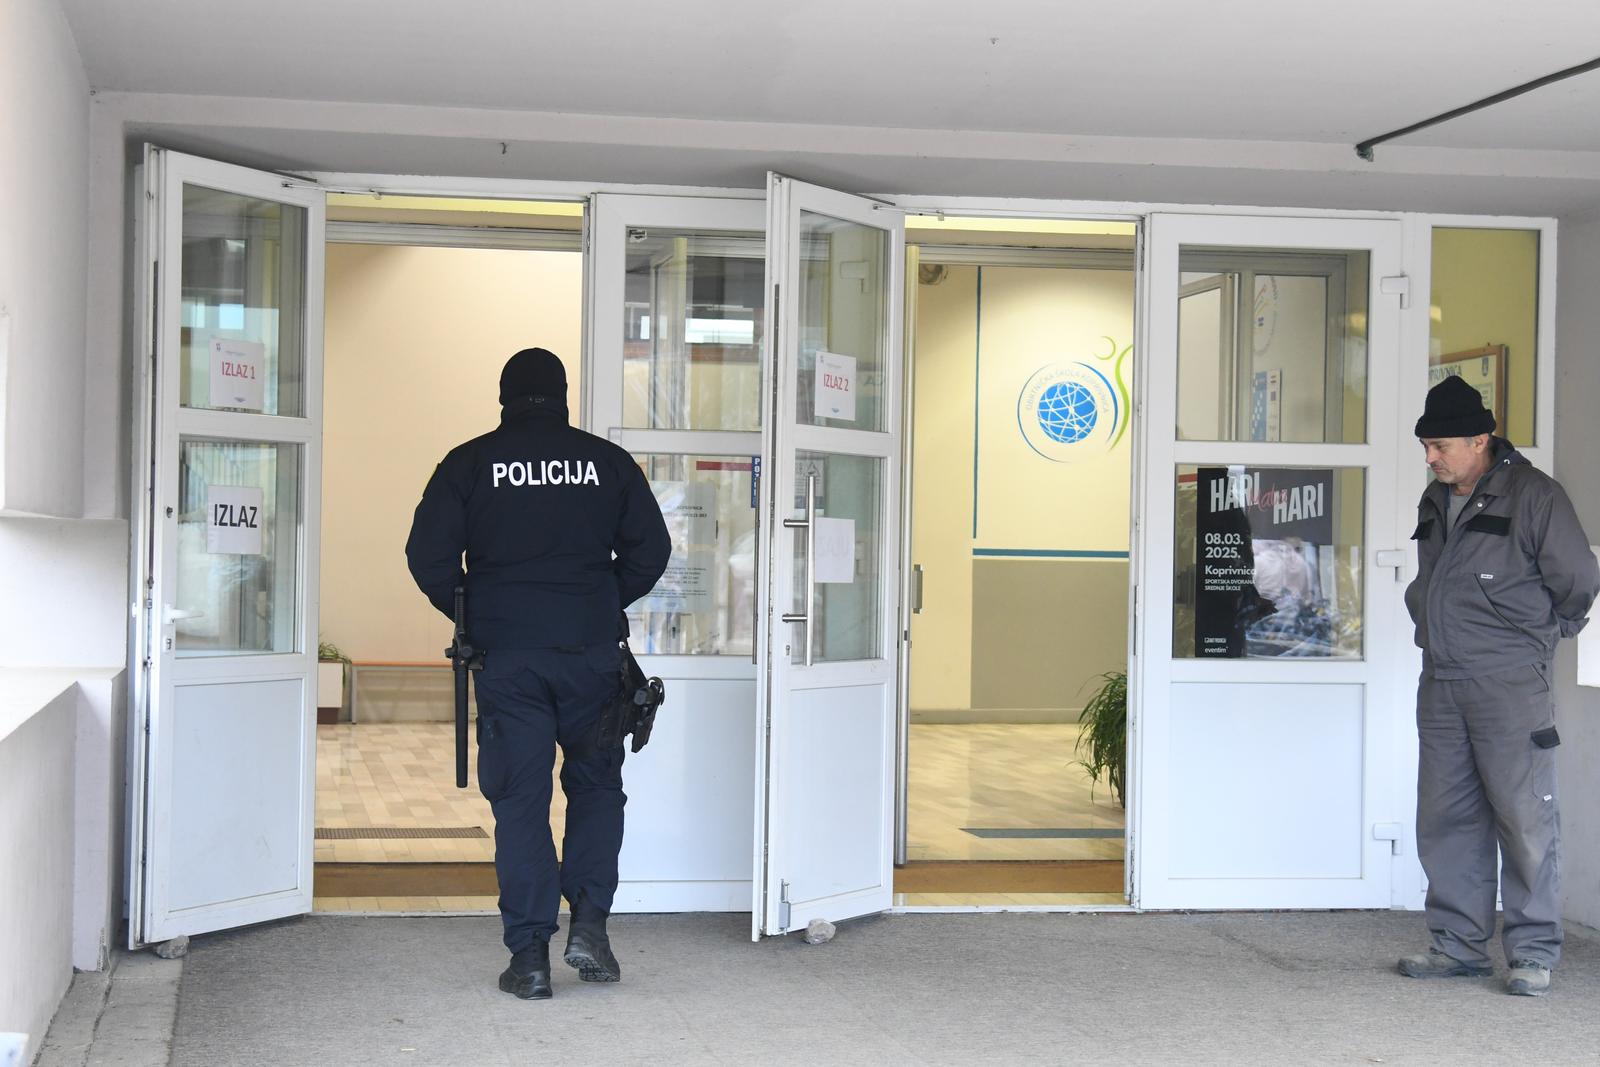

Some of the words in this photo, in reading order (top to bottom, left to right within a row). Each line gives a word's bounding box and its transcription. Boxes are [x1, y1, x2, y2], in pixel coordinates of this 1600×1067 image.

[221, 360, 249, 379] IZLAZ
[250, 365, 256, 380] 1
[823, 373, 843, 391] IZLAZ
[843, 378, 849, 392] 2
[492, 459, 600, 488] POLICIJA
[1210, 471, 1260, 513] HARI
[1273, 482, 1324, 525] HARI
[214, 503, 258, 529] IZLAZ
[1204, 532, 1245, 546] 08.03.
[1204, 546, 1242, 559] 2025.
[1204, 564, 1257, 578] Koprivnica
